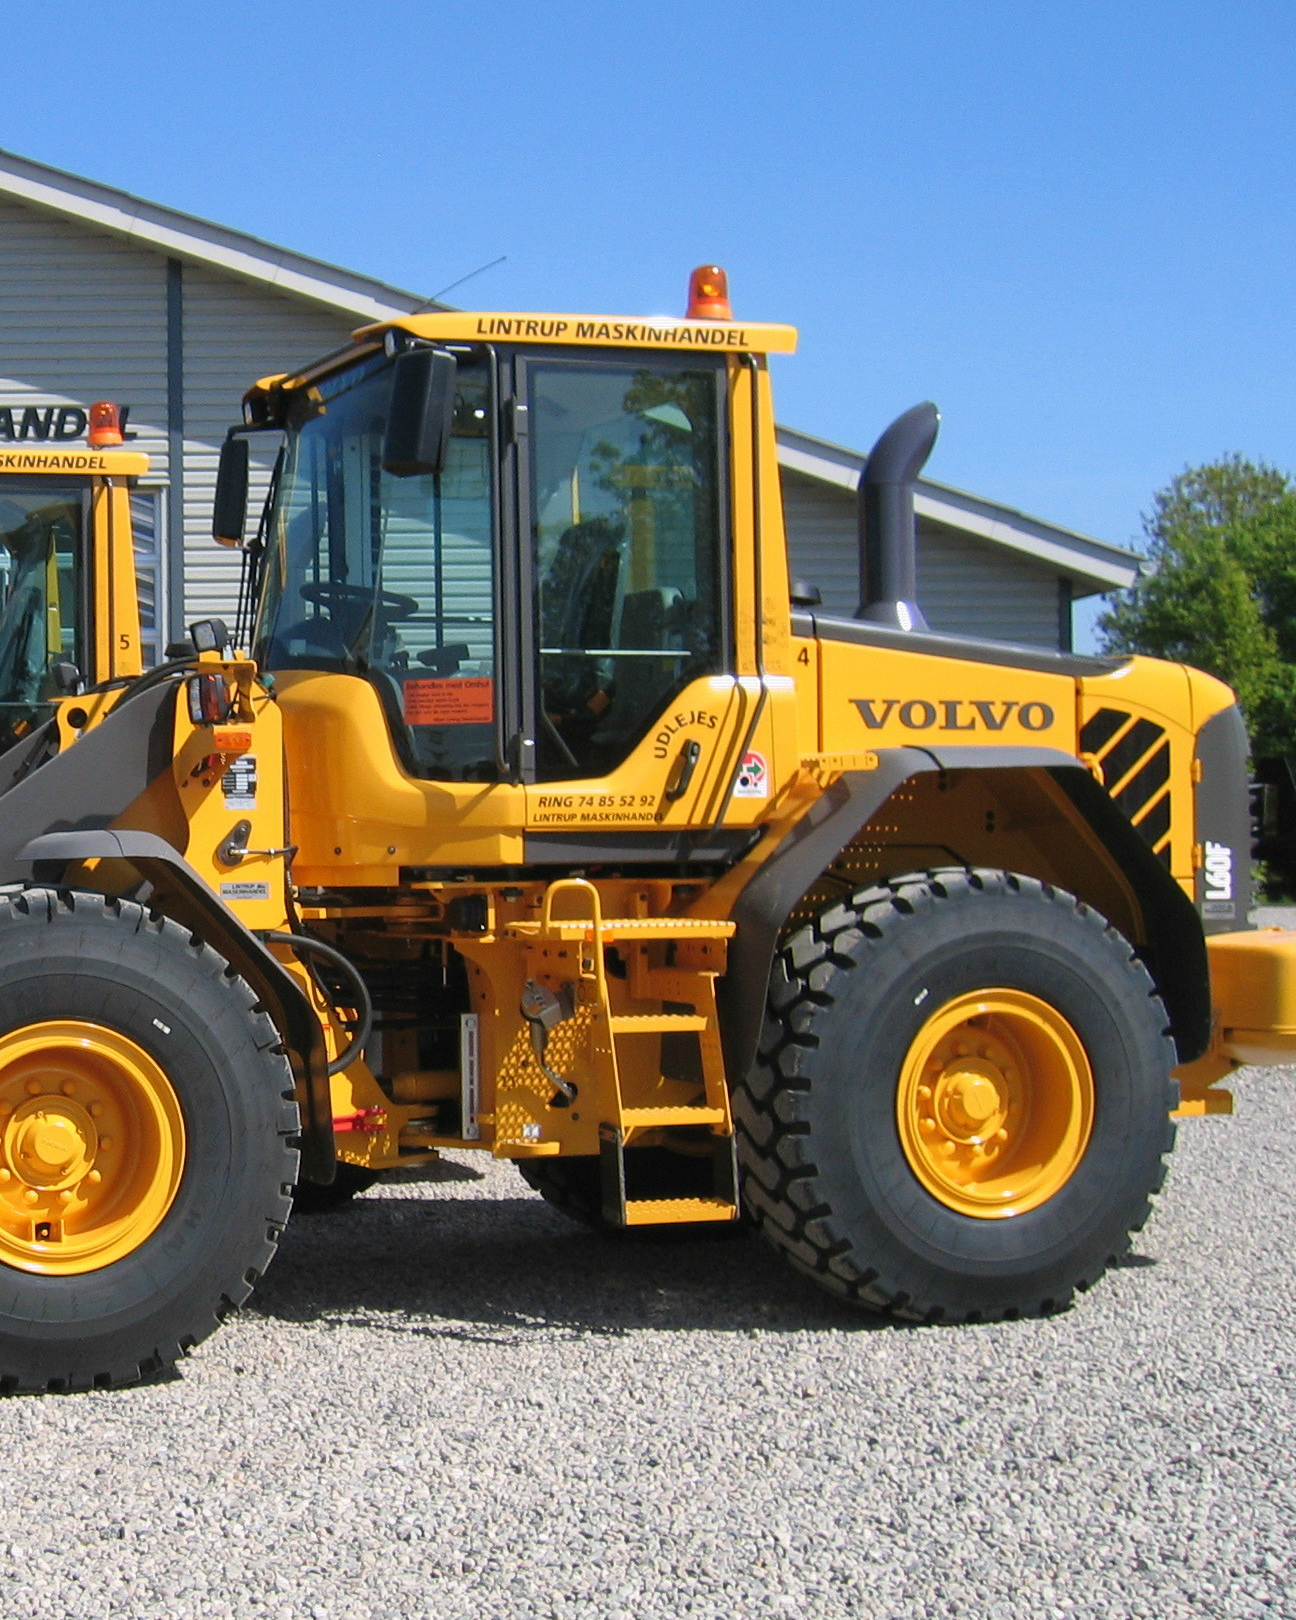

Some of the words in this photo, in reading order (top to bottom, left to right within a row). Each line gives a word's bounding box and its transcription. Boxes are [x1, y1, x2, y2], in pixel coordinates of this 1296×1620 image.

[476, 317, 568, 337] LINTRUP
[575, 322, 749, 347] MASKINHANDEL
[119, 634, 130, 650] 5
[797, 647, 810, 667] 4
[848, 699, 1055, 731] VOLVO
[654, 710, 718, 759] UDLEJES
[538, 796, 573, 808] RING
[578, 796, 594, 807] 74
[598, 796, 615, 807] 85
[619, 795, 635, 807] 52
[639, 795, 656, 806] 92
[533, 813, 577, 823] LINTRUP
[580, 812, 663, 822] MASKINHANDEL
[1205, 840, 1232, 899] L60F
